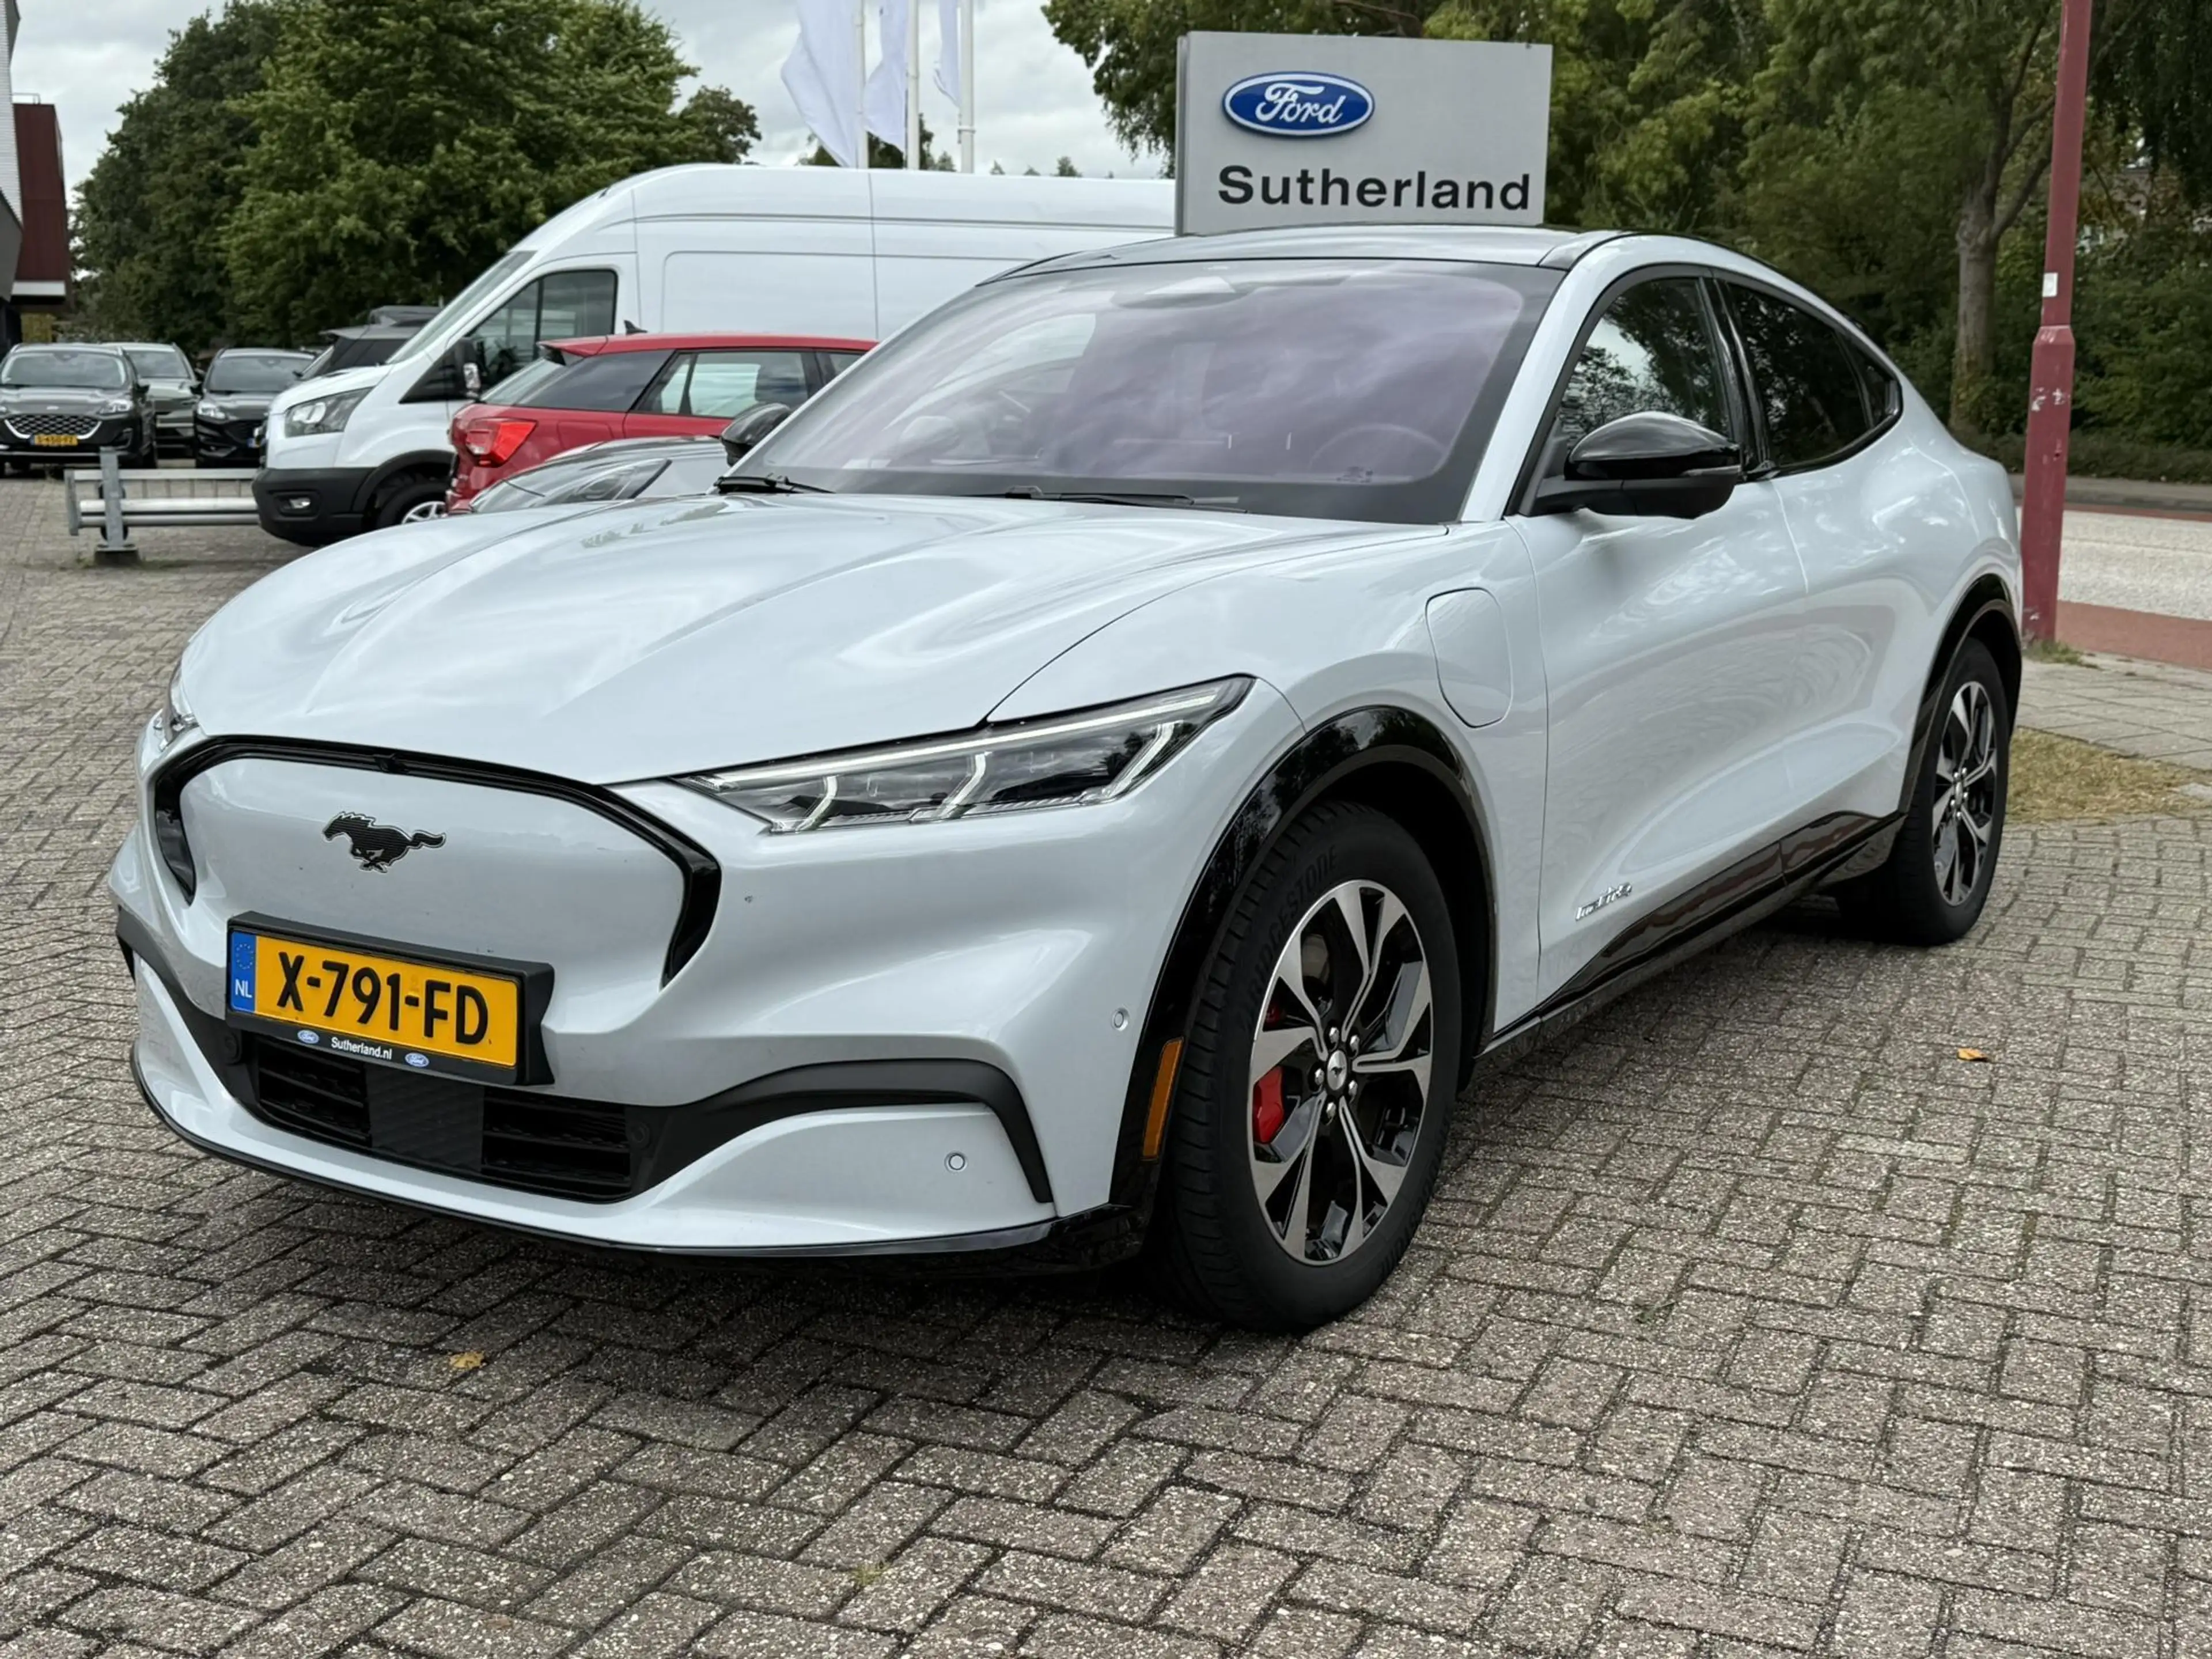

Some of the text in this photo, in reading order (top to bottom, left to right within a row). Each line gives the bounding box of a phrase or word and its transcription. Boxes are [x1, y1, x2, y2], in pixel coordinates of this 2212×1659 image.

[1255, 81, 1347, 124] Ford
[1218, 164, 1530, 211] Sutherland
[235, 978, 253, 998] NL
[276, 951, 488, 1046] X-791-FD
[331, 1036, 392, 1060] Sutherland.nl
